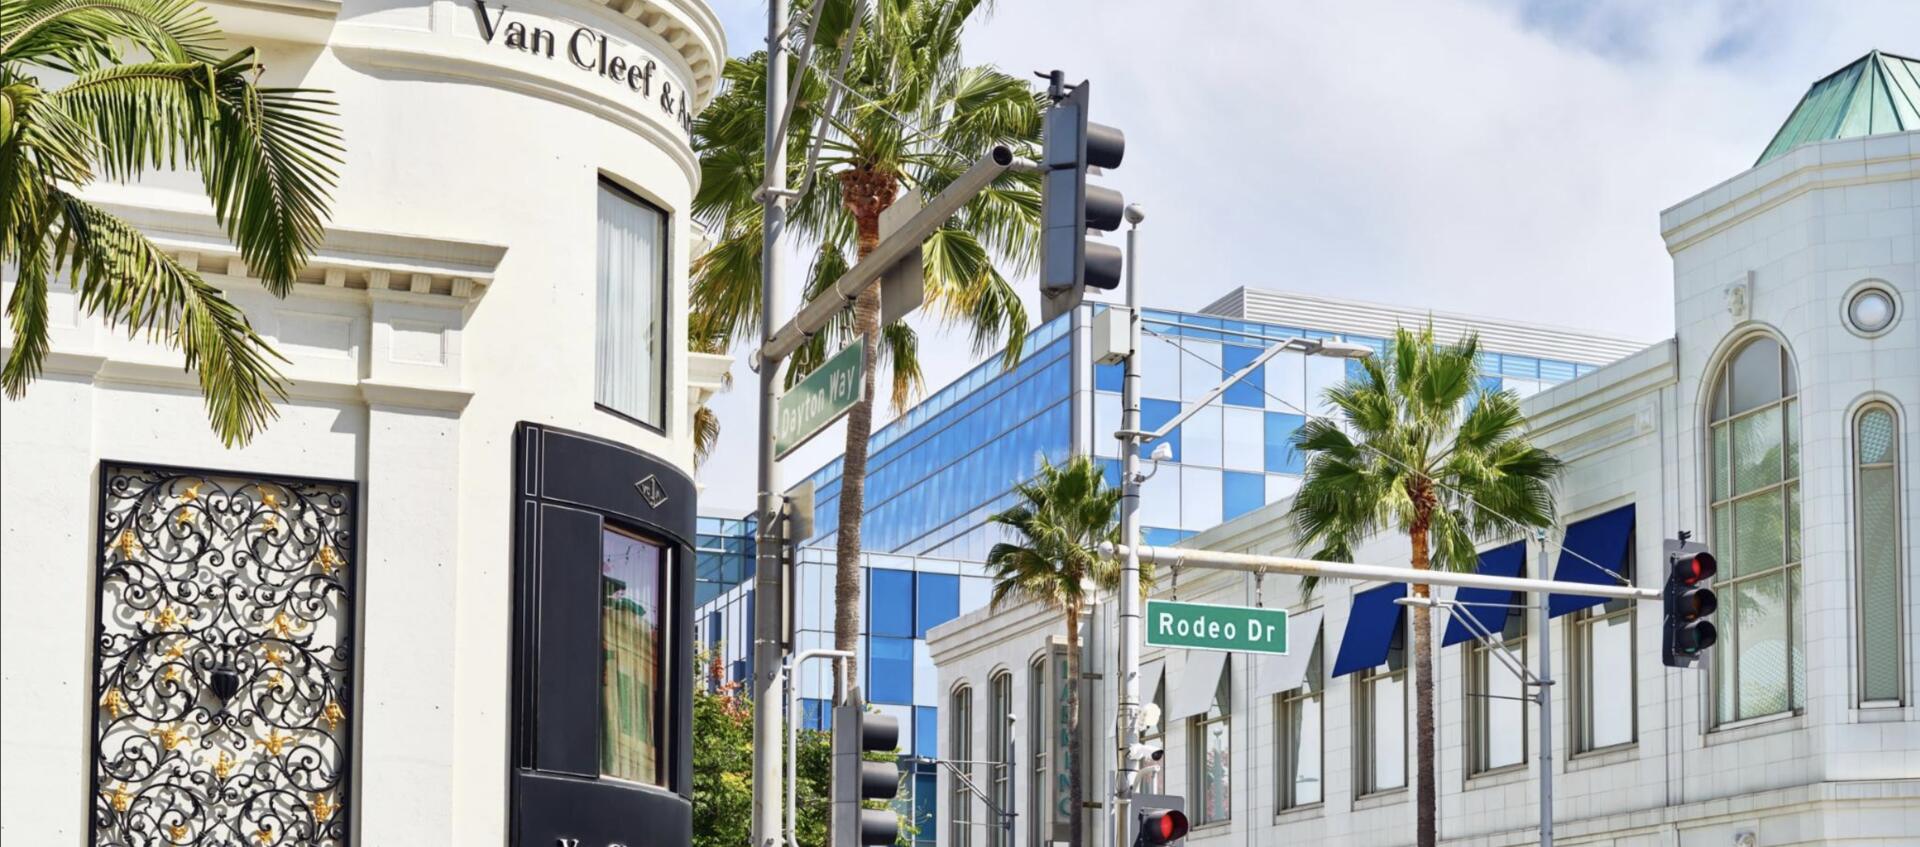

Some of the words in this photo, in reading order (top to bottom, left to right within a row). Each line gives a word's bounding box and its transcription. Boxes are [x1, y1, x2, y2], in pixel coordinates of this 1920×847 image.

[474, 0, 555, 58] Van
[568, 27, 656, 97] Cleef
[660, 81, 674, 115] &
[781, 388, 825, 440] Dayton
[829, 366, 855, 404] Way
[1159, 612, 1236, 640] Rodeo
[1248, 619, 1275, 642] Dr
